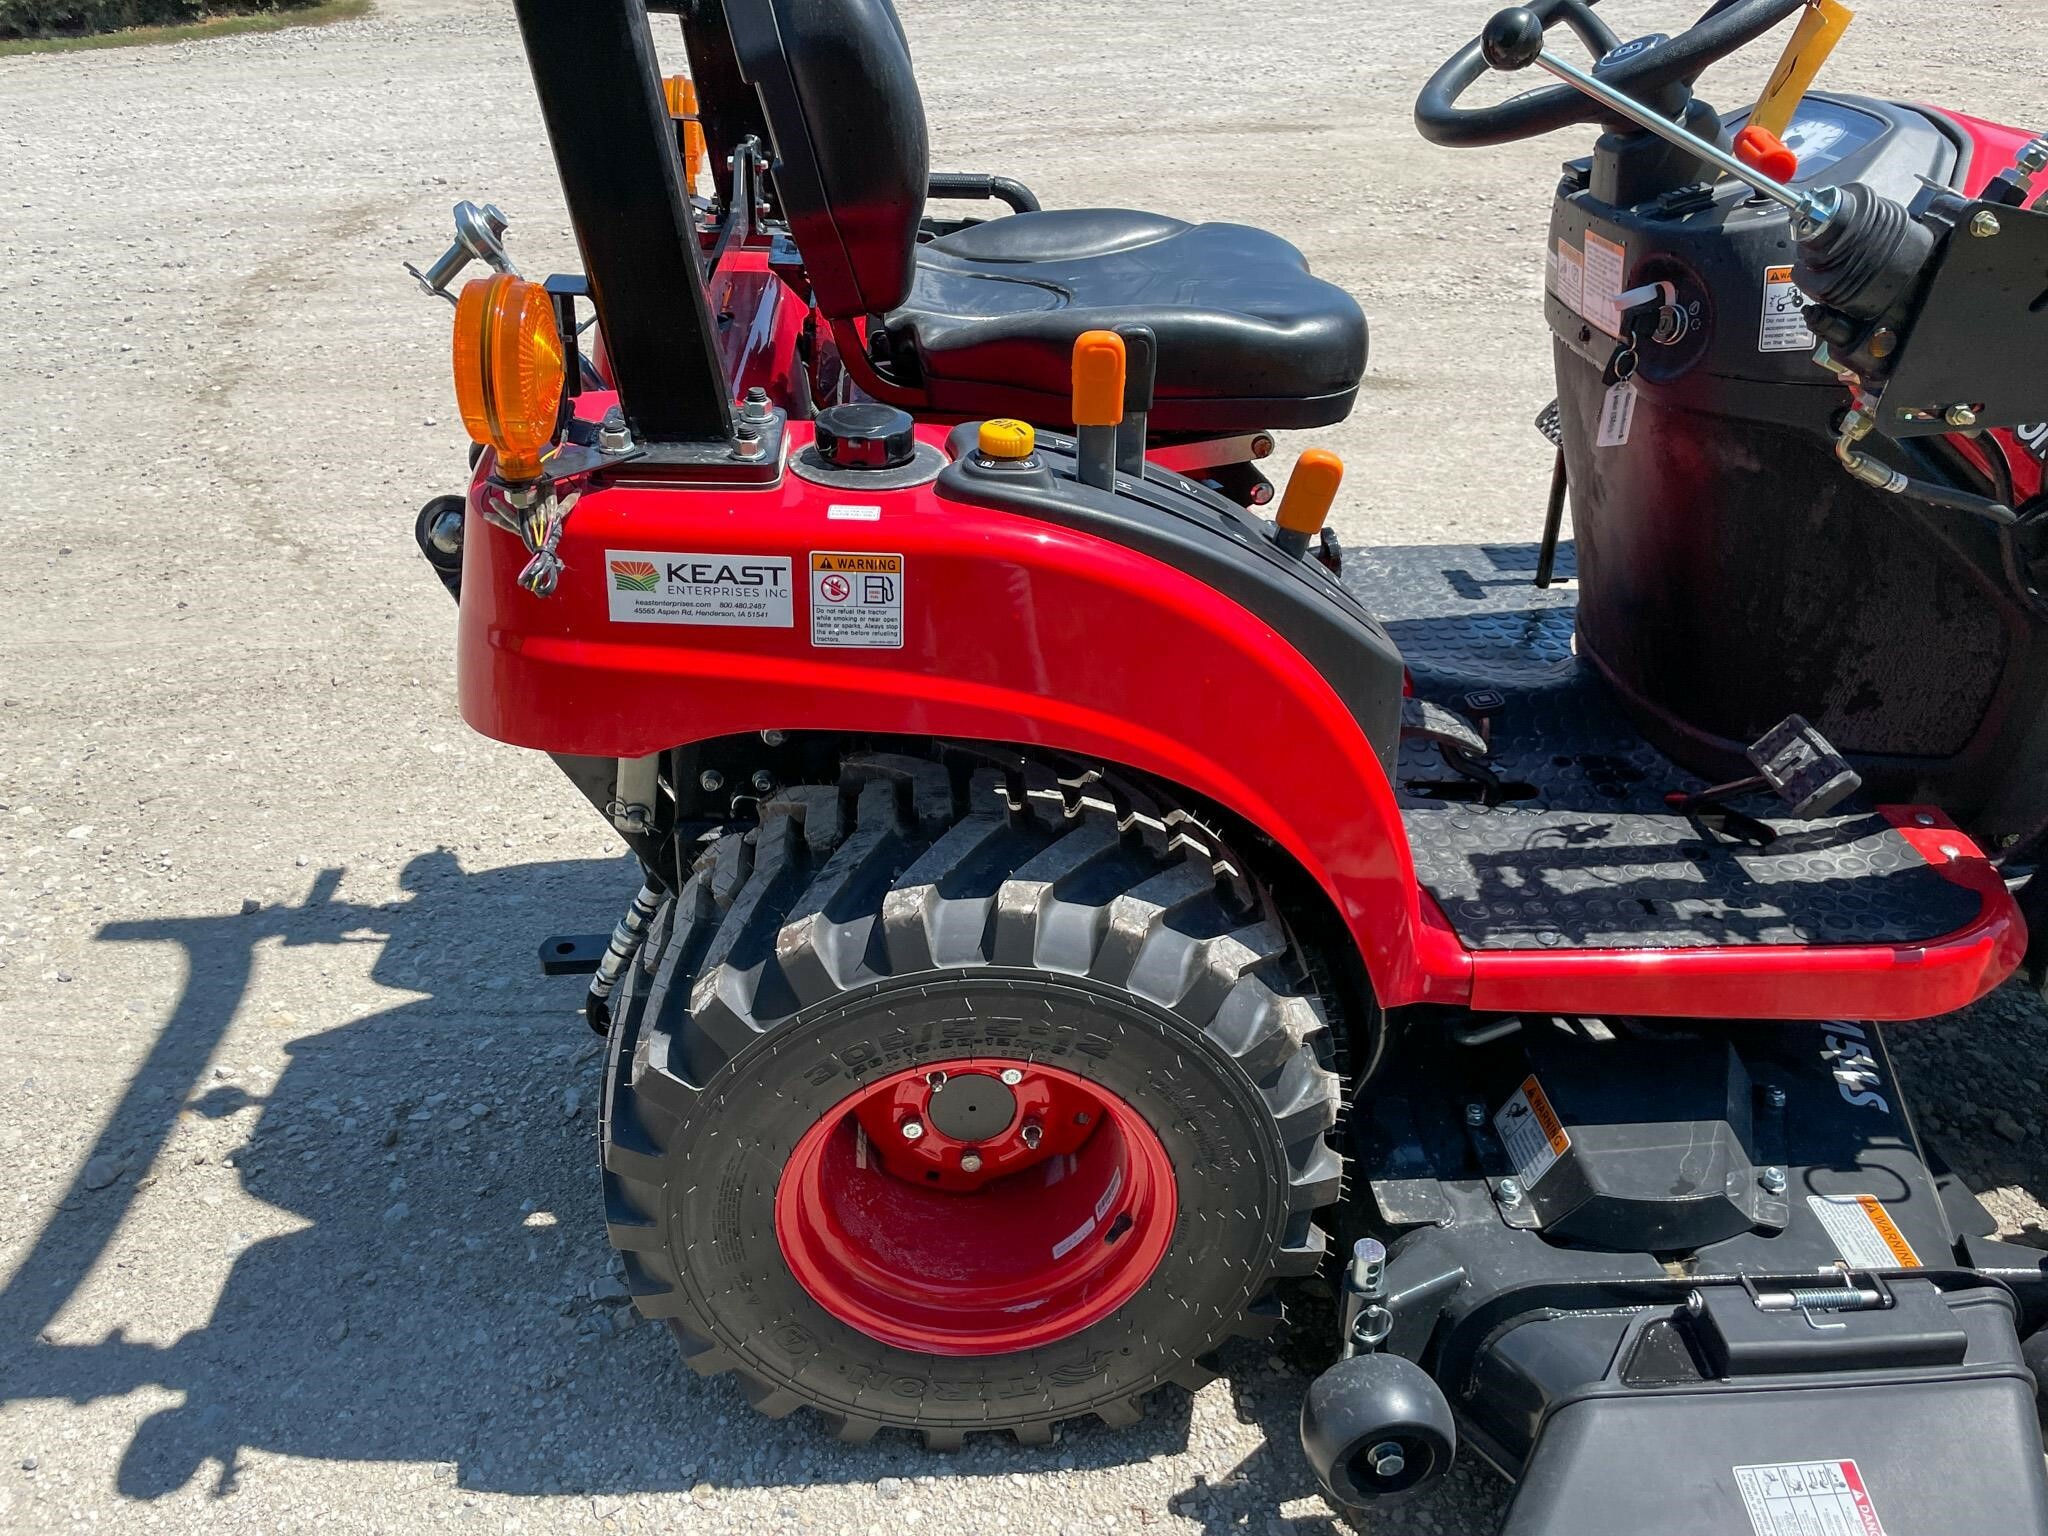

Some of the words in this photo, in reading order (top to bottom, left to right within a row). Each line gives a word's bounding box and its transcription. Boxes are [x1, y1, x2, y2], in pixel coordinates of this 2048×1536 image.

[837, 558, 896, 571] WARNING
[666, 563, 787, 586] KEAST
[667, 585, 760, 598] ENTERPRISES
[765, 588, 788, 598] INC
[635, 599, 712, 609] keastenterprises.com
[657, 608, 680, 617] Aspen
[695, 610, 736, 618] Henderson,
[1526, 1087, 1562, 1147] WARNING
[1874, 1214, 1918, 1268] WARNING
